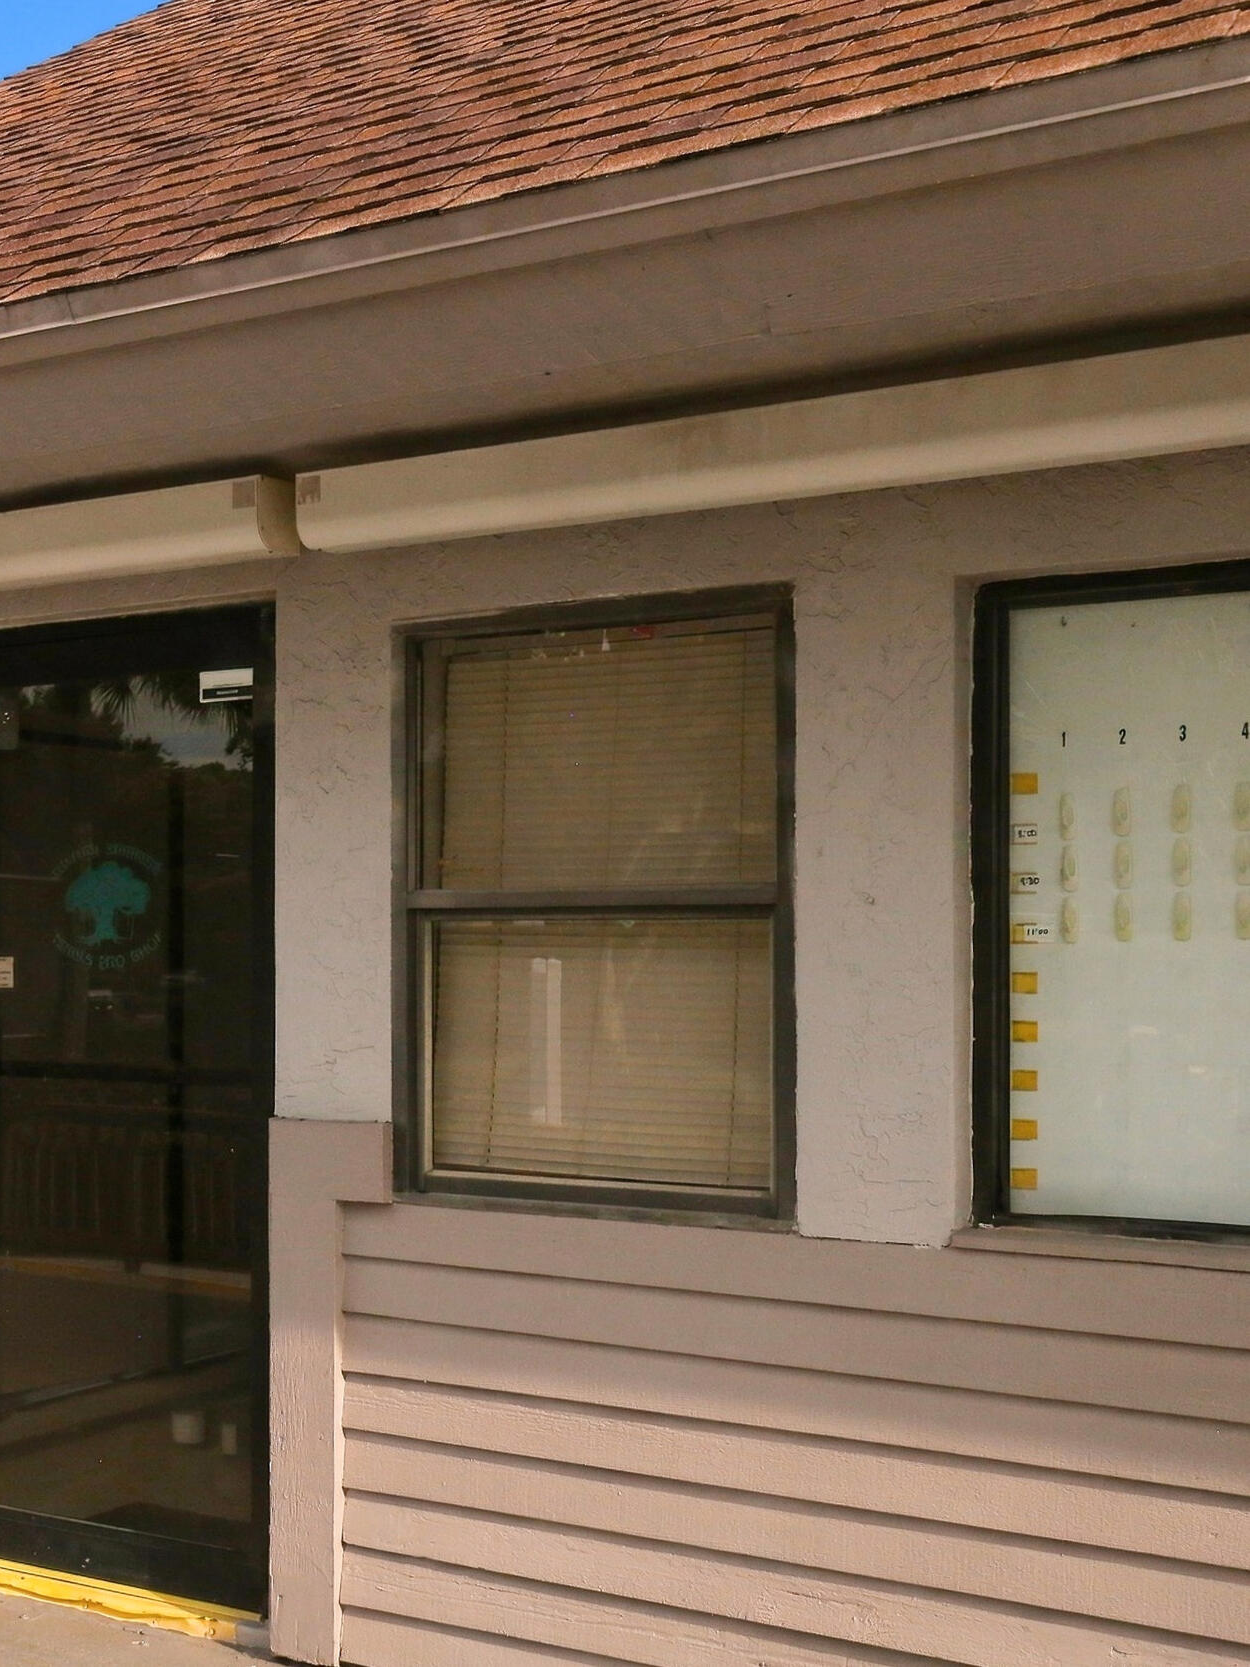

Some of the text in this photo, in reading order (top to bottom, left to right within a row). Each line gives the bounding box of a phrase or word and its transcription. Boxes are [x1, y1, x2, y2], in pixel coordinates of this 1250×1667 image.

[1061, 721, 1249, 747] 1 2 3 4
